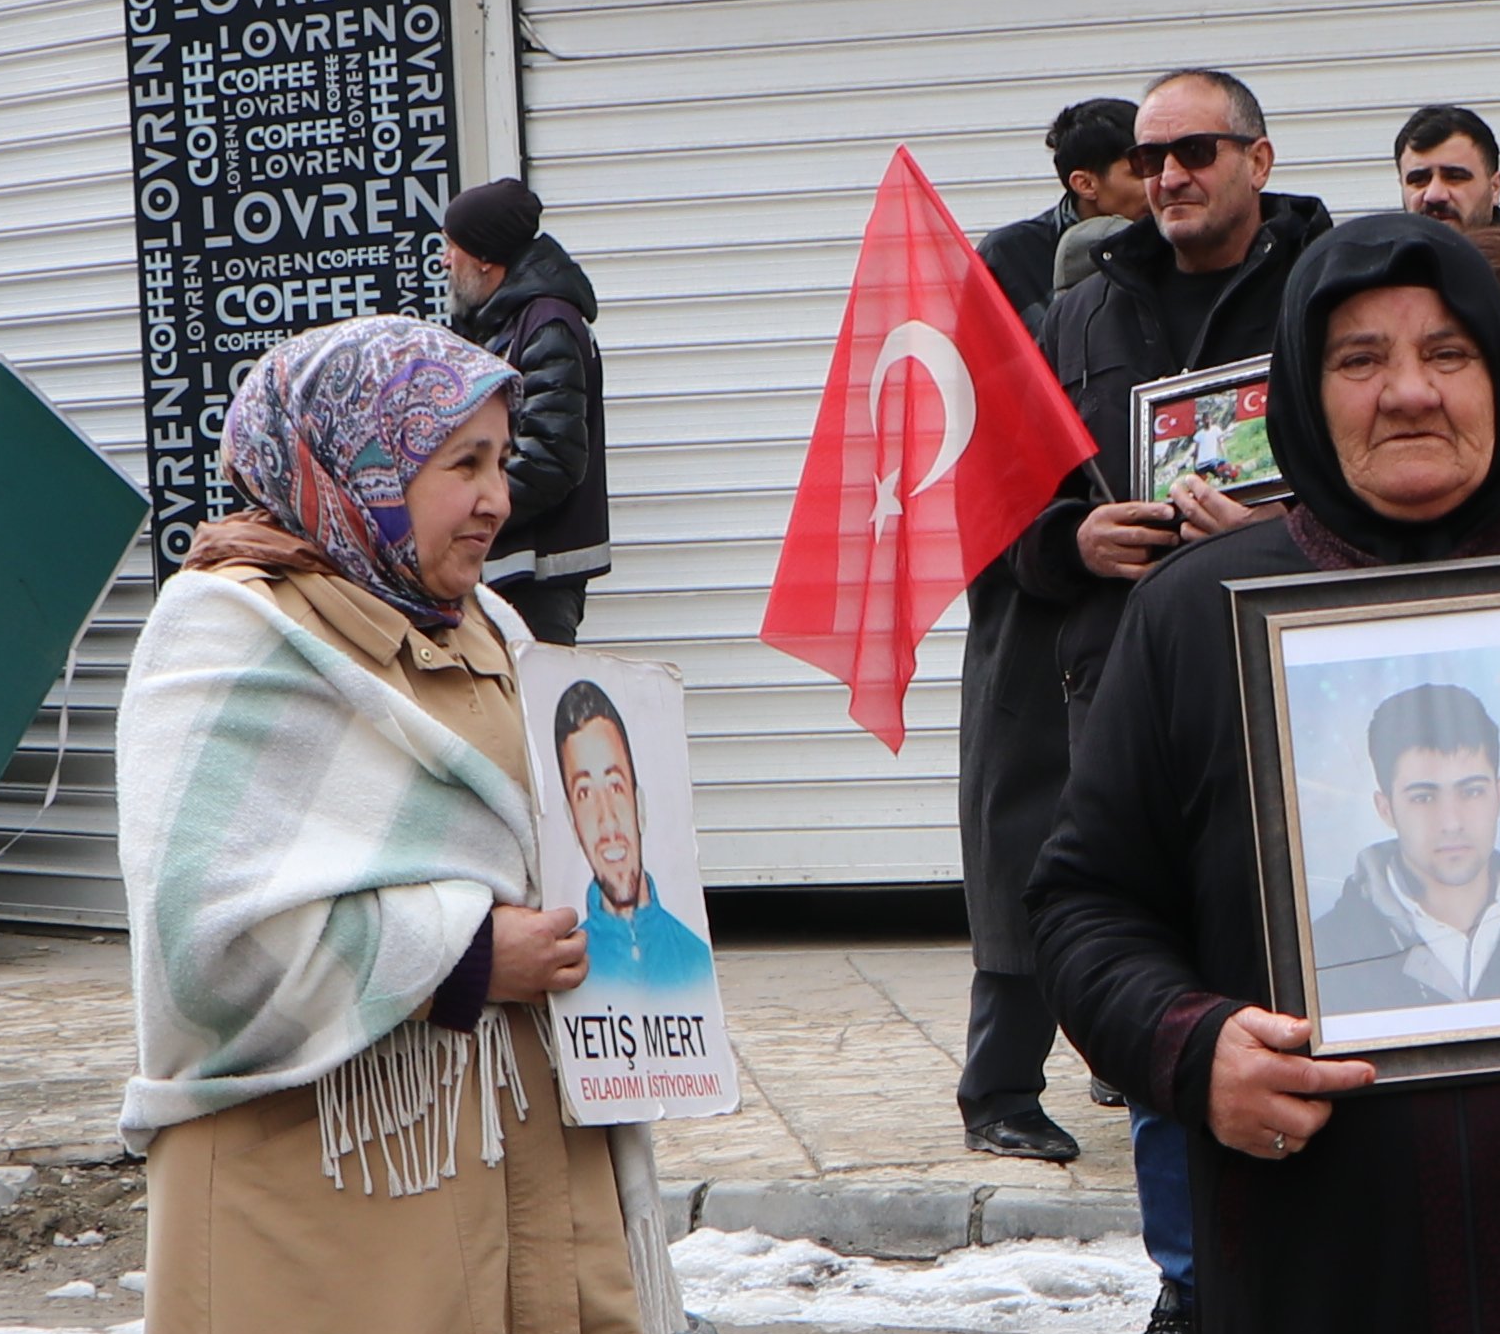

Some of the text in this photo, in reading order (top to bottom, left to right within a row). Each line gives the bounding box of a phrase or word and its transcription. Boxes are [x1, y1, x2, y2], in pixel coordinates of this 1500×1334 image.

[219, 5, 397, 63] LOVREN
[218, 60, 318, 95] COFFEE
[222, 89, 320, 121] LOVREN
[324, 53, 341, 114] COFFEE
[345, 52, 367, 140] LOVREN
[131, 33, 181, 250] LOVREN
[181, 39, 220, 187] COFFEE
[245, 117, 346, 152] COFFEE
[368, 45, 402, 176] COFFEE
[225, 124, 242, 195] LOVREN
[250, 145, 366, 182] LOVREN
[202, 173, 449, 249] LOVREN
[211, 245, 391, 282] LOVREN COFFEE
[394, 231, 420, 318] OVREN
[145, 250, 179, 376] COFFEE
[182, 254, 206, 354] LOVREN
[215, 274, 382, 326] COFFEE
[214, 329, 286, 352] COFFEE
[150, 377, 197, 564] OVREN
[563, 1005, 708, 1070] YETİŞ MERT
[580, 1069, 723, 1101] EVLADIMI İSTİYORUM!
